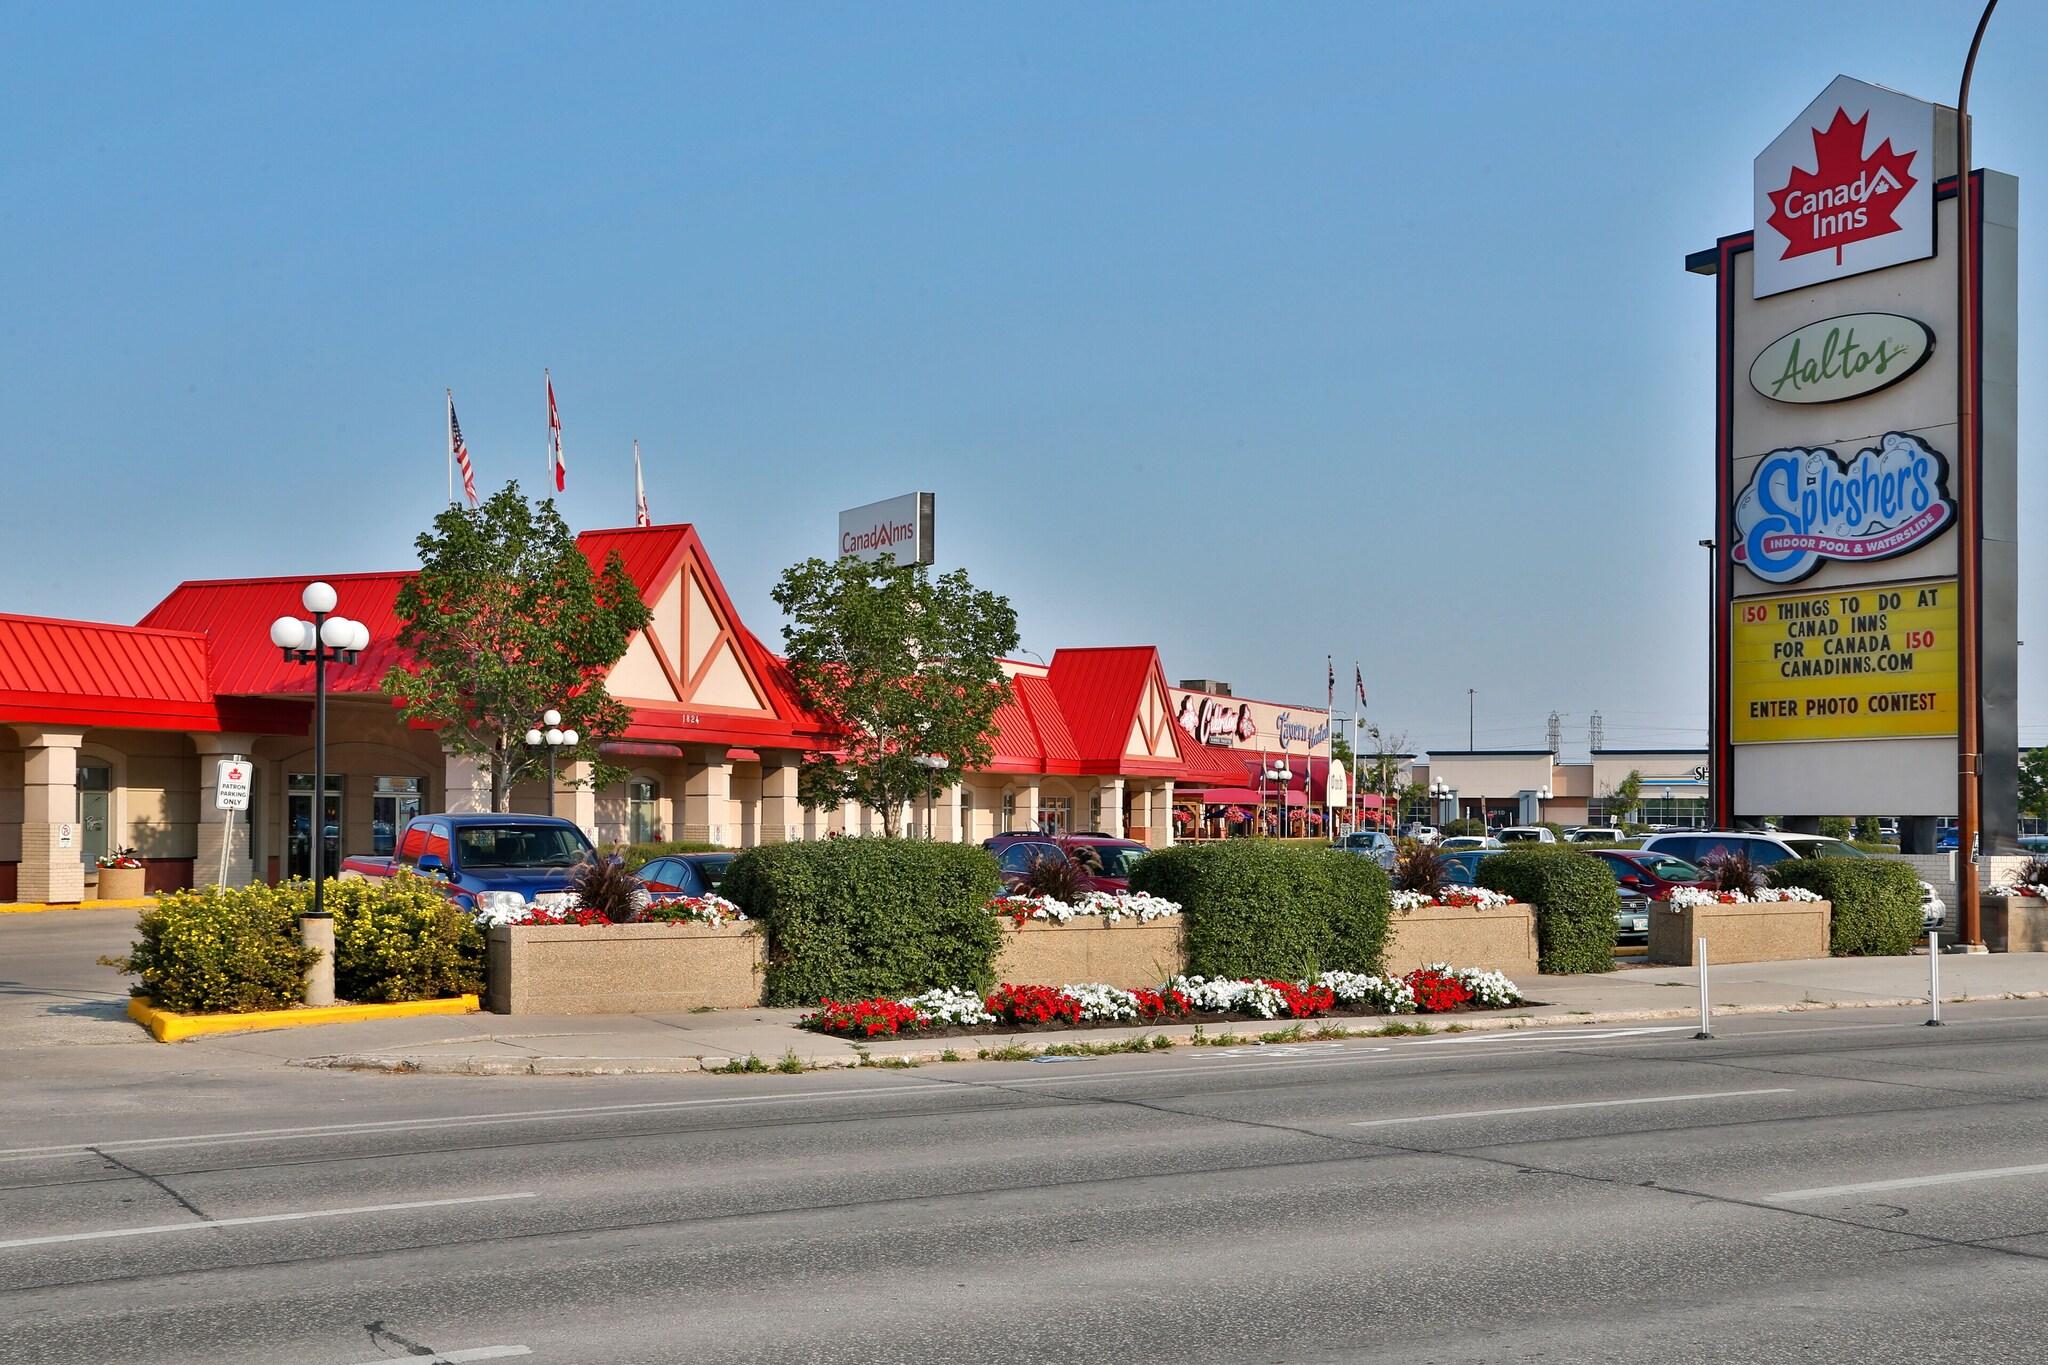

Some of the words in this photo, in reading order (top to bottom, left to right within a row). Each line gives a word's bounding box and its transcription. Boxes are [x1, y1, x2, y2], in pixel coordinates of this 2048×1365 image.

[1813, 207, 1868, 240] Inns
[1771, 327, 1908, 397] Aaltos
[1747, 449, 1930, 573] Splasher's
[1818, 541, 1850, 554] POOL
[1853, 543, 1863, 554] &
[1865, 512, 1936, 552] WATERSLIDE
[1742, 604, 1768, 624] 150
[1777, 599, 1830, 621] THINGS
[1839, 596, 1860, 615] TO
[1878, 593, 1902, 612] DO
[1917, 588, 1939, 608] AT
[1788, 620, 1839, 639] CANAD
[1851, 614, 1888, 634] INNS
[1774, 641, 1804, 660] FOR
[1823, 634, 1892, 656] CANADA
[1906, 630, 1935, 650] 150
[1780, 653, 1914, 678] CANADINNS.COM
[1750, 700, 1798, 719] ENTER
[1806, 697, 1859, 716] PHOTO
[1868, 692, 1937, 713] CONTEST
[1276, 711, 1307, 749] Tavern
